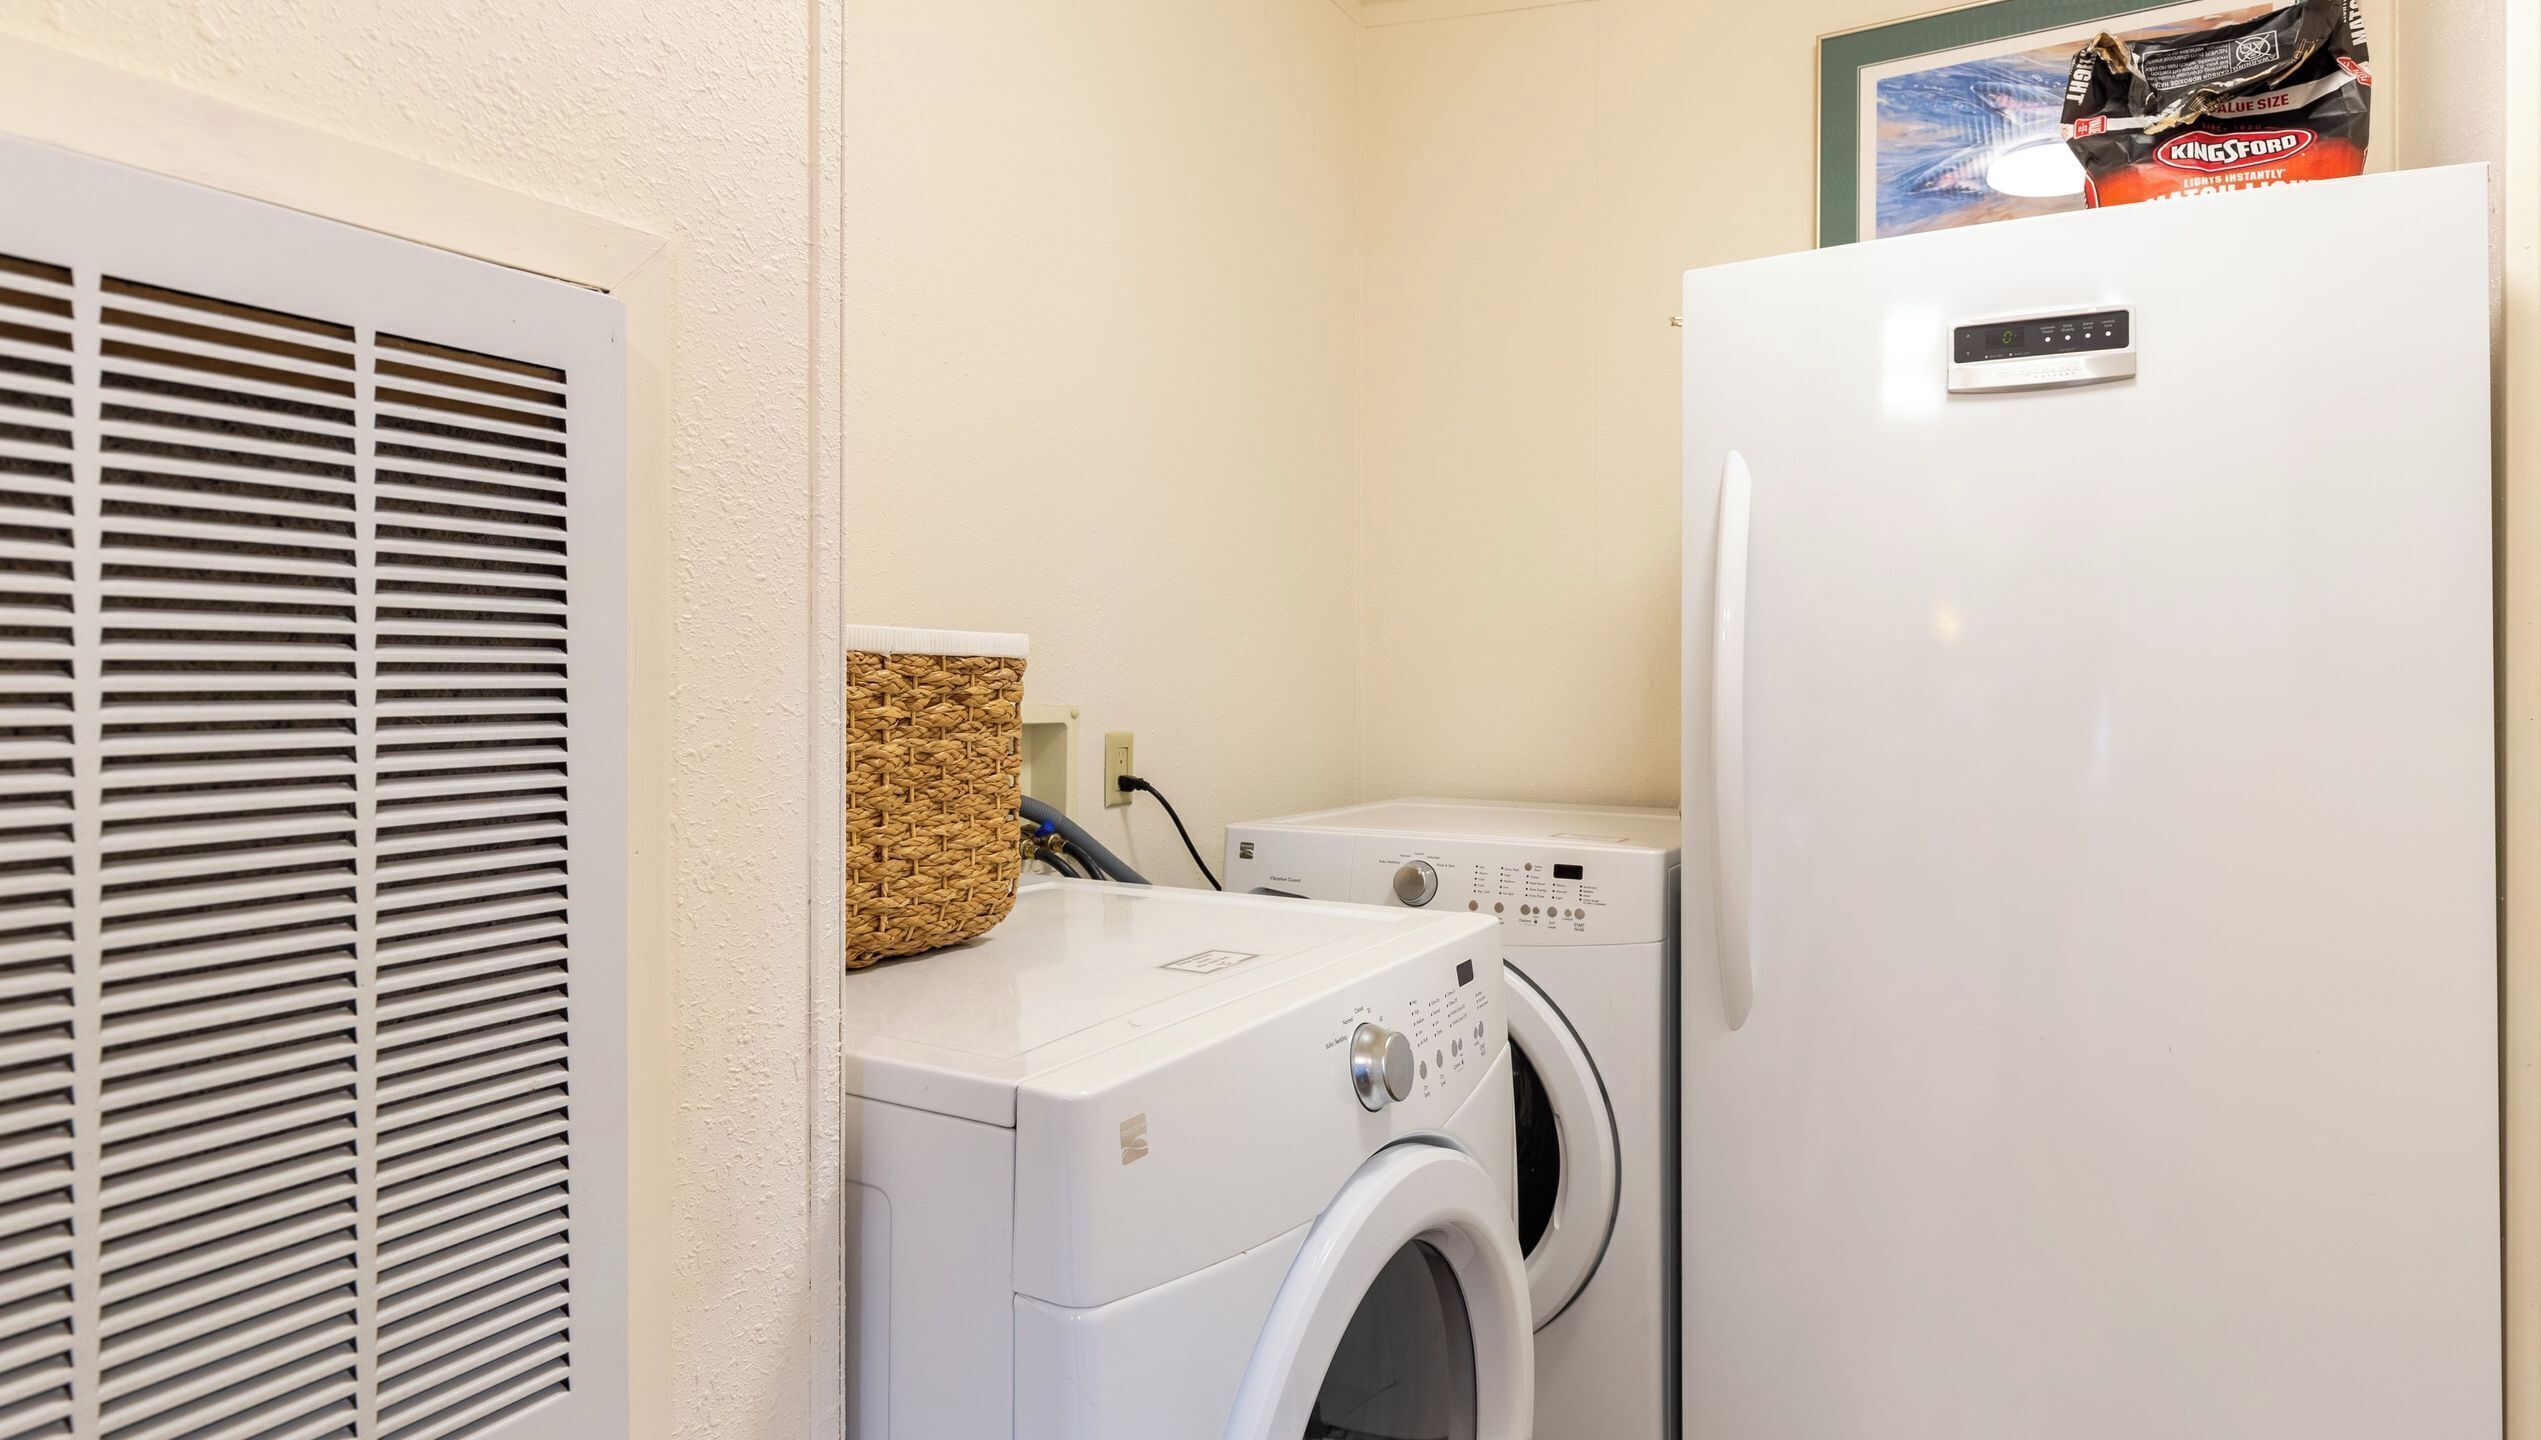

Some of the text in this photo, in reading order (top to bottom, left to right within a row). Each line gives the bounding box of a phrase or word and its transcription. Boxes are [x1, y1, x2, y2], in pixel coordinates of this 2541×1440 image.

[2205, 49, 2228, 57] NEVER
[2163, 54, 2190, 63] charcoal
[2232, 57, 2269, 72] WARNING
[2176, 70, 2203, 79] charcoal
[2203, 70, 2229, 79] CARBON
[2170, 76, 2202, 86] MONOXIDE
[2215, 93, 2290, 113] ALUE SIZE
[2171, 134, 2298, 164] KINGSFORD
[2183, 169, 2284, 188] LIGHTS INSTANTLY
